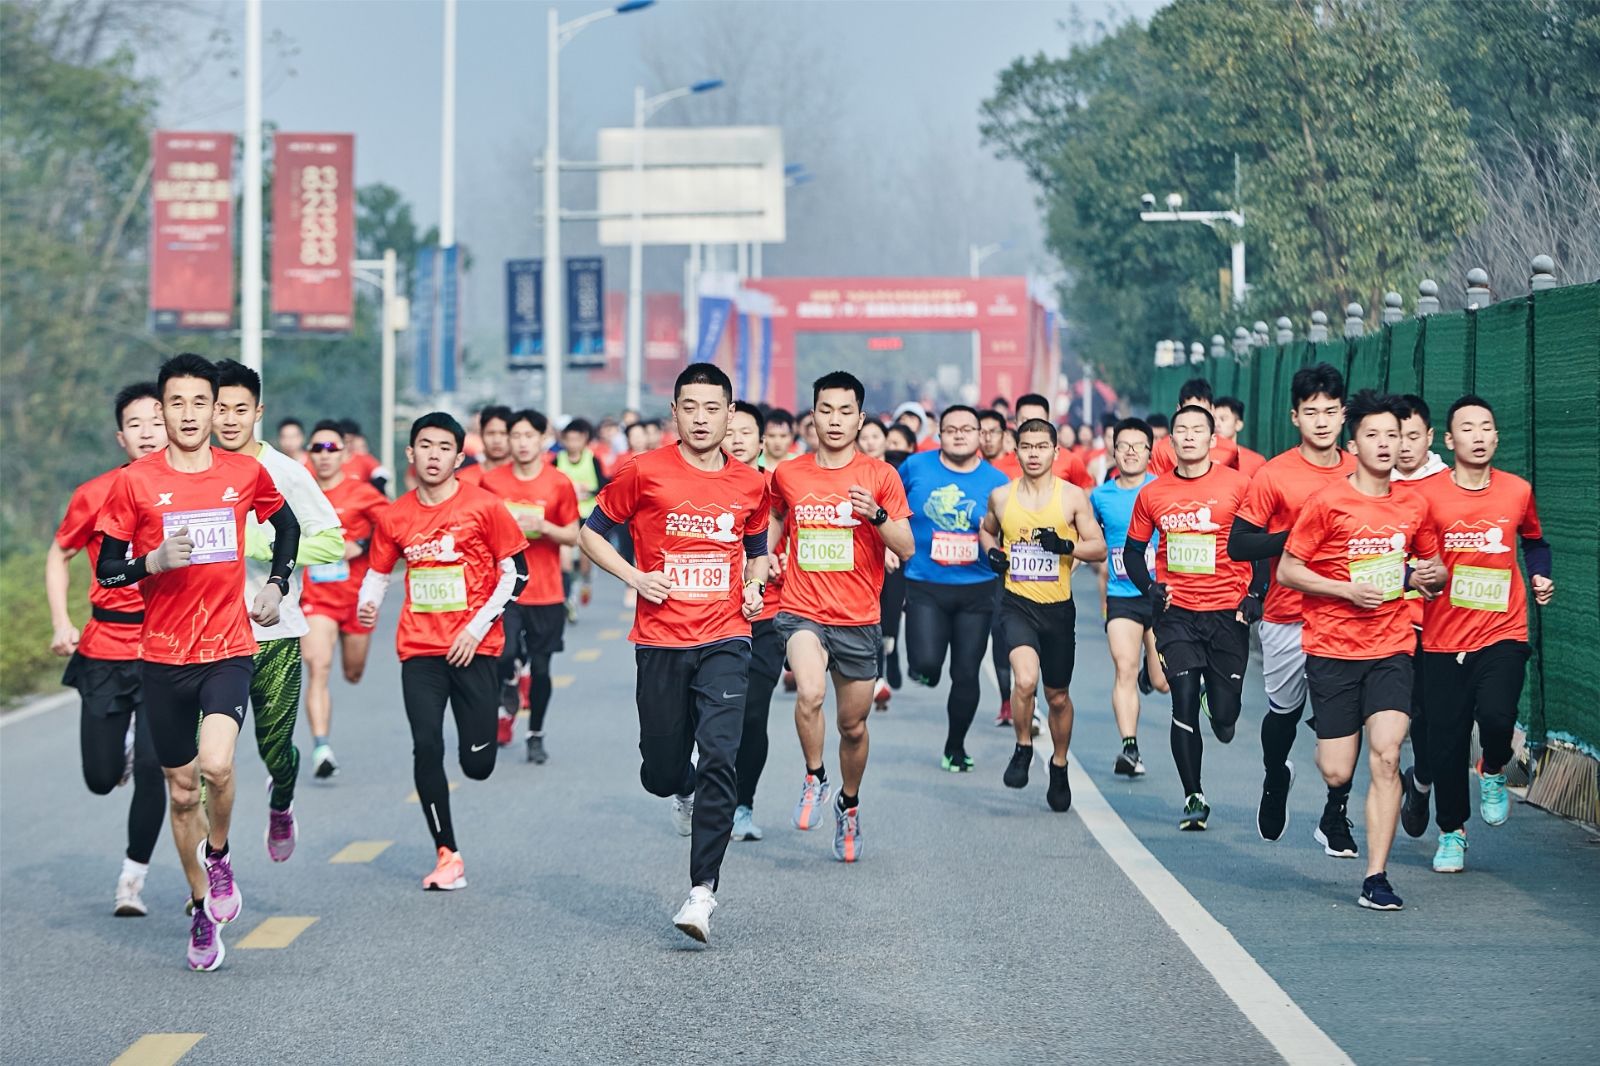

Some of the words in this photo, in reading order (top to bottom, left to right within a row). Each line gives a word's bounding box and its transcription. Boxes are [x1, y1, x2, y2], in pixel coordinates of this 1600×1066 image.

[665, 512, 715, 534] 2020
[800, 543, 845, 559] C1062
[934, 543, 972, 559] A1135
[1169, 545, 1208, 563] C1073
[1011, 556, 1053, 572] D1073
[669, 567, 722, 587] A1189
[413, 582, 456, 600] C1061
[1455, 579, 1502, 600] C1040
